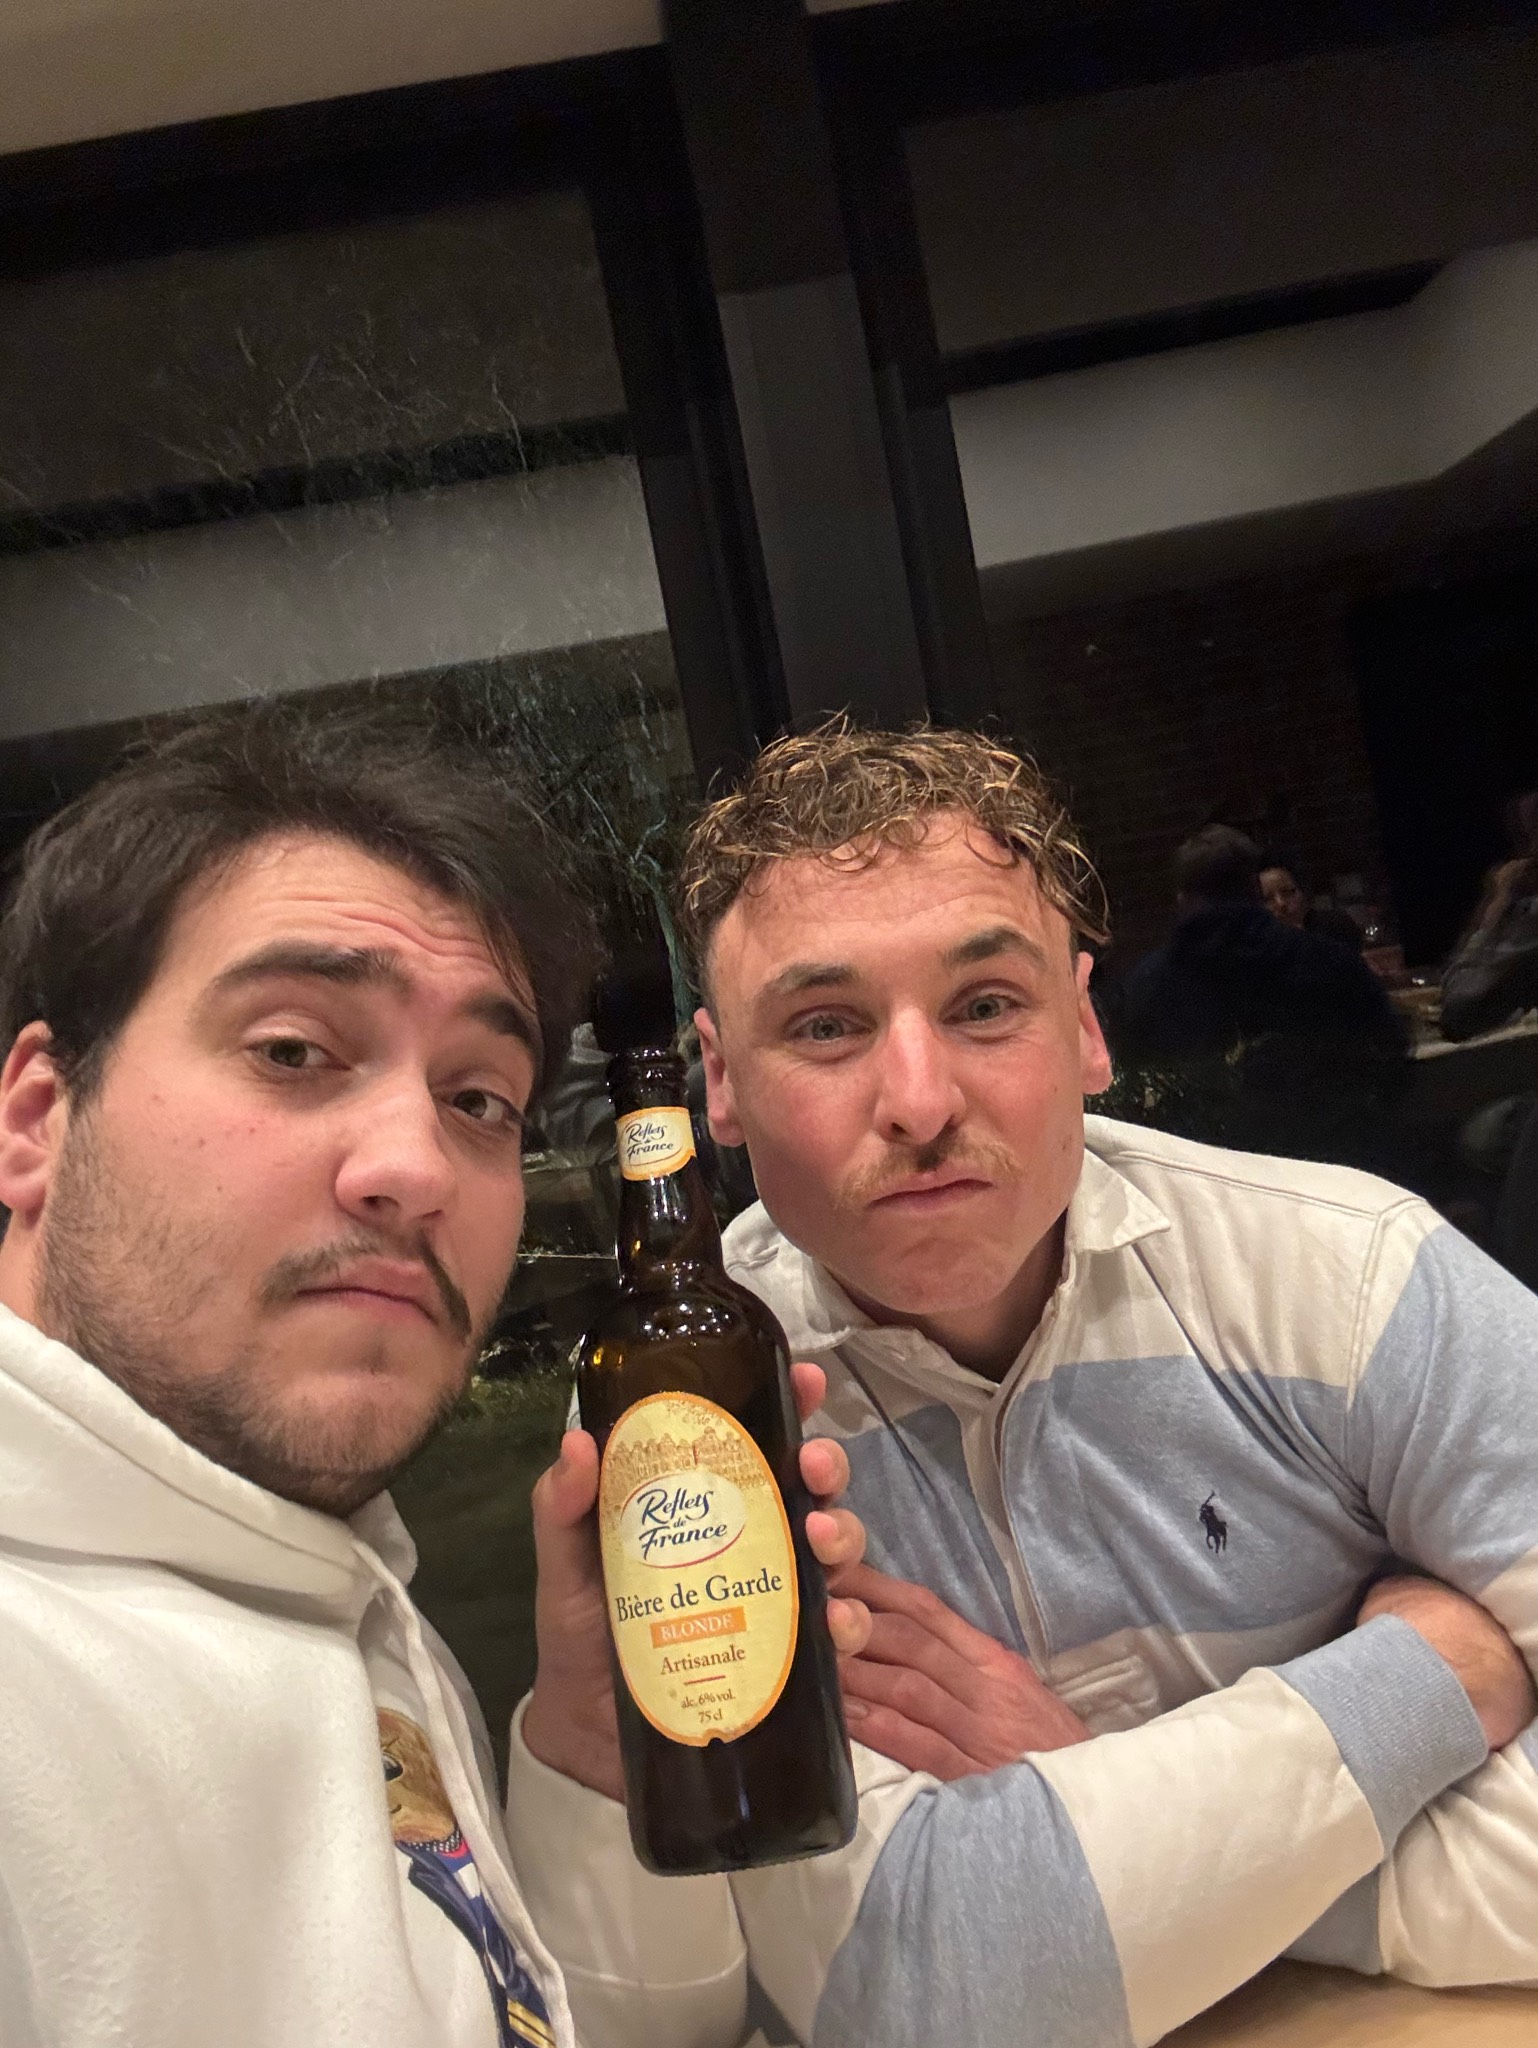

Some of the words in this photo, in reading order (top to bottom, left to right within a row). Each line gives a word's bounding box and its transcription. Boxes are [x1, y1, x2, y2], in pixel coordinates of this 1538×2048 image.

[626, 1122, 667, 1144] Reflets
[627, 1142, 674, 1161] France
[637, 1487, 714, 1526] Reflets
[673, 1516, 687, 1528] de
[638, 1523, 728, 1561] France
[615, 1594, 665, 1622] Bière
[670, 1582, 699, 1610] de
[705, 1567, 783, 1602] Garde
[660, 1613, 734, 1641] BLONDE
[660, 1644, 747, 1675] Artisanale
[698, 1710, 712, 1724] 75
[713, 1708, 722, 1721] cl
